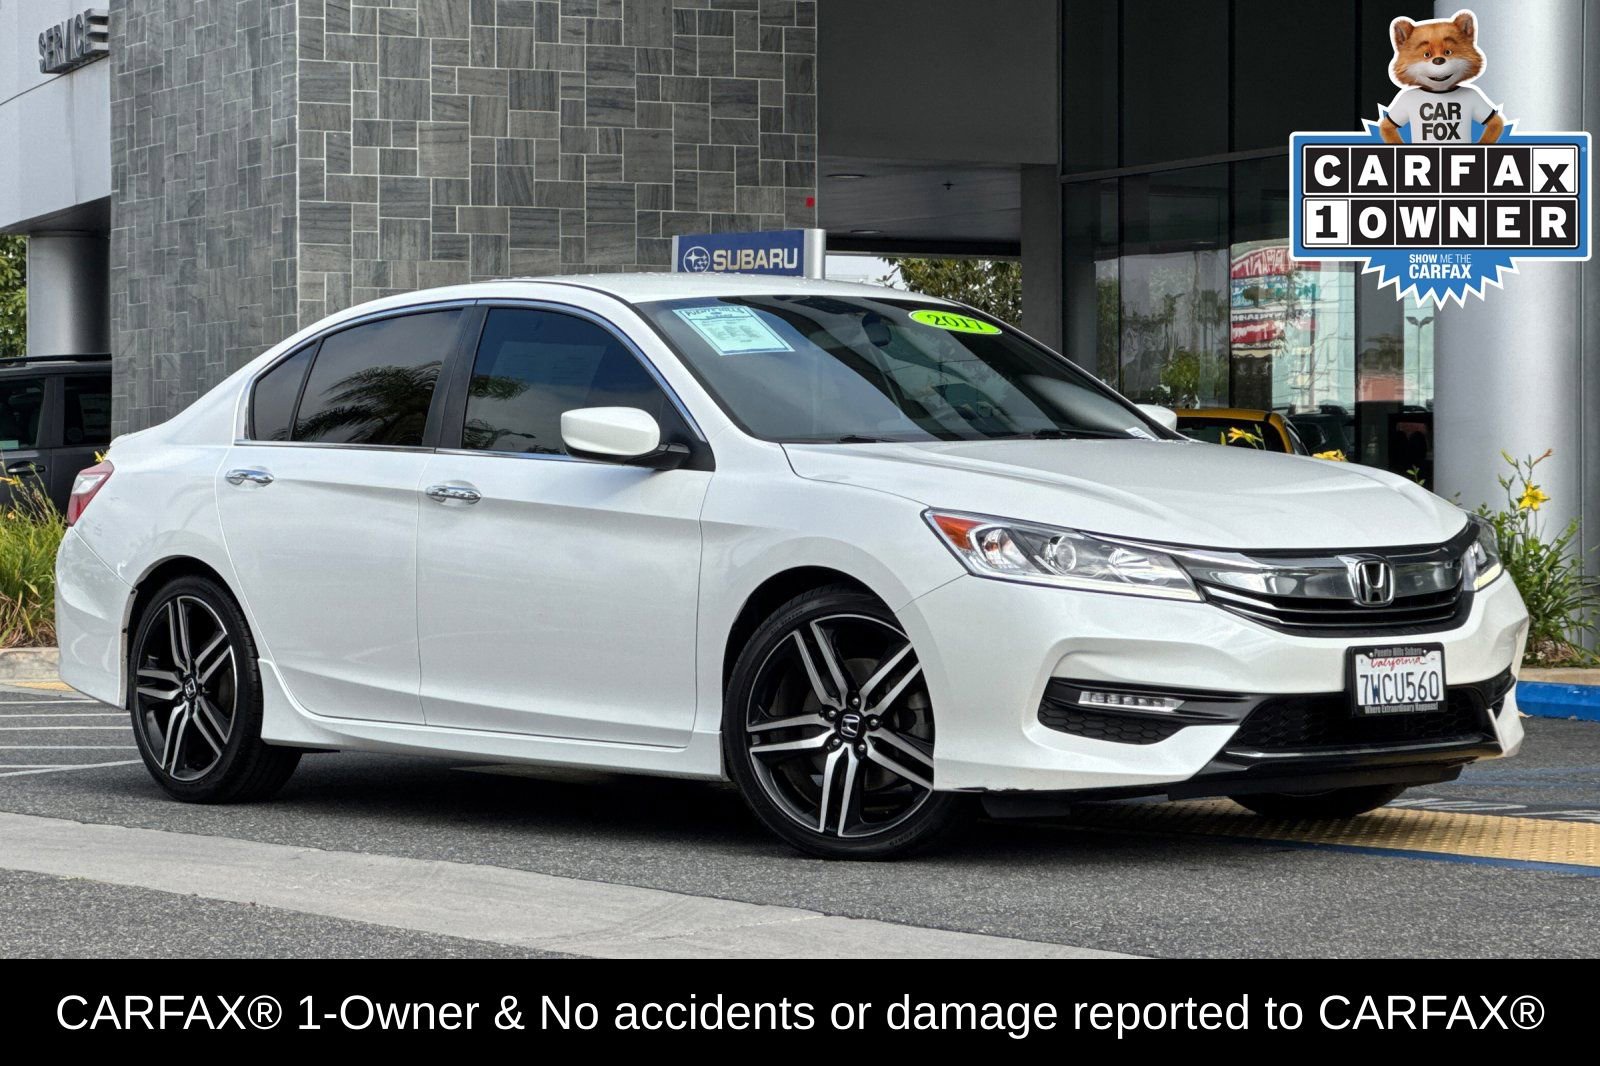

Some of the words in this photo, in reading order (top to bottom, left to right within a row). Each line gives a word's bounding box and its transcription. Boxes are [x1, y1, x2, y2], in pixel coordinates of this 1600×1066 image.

[38, 8, 109, 73] SERVICE
[713, 248, 798, 271] SUBARU
[927, 314, 983, 330] 2017
[1374, 648, 1392, 657] Puente
[1393, 647, 1404, 656] Hills
[1405, 647, 1422, 656] Subaru
[1371, 656, 1425, 671] California
[1360, 671, 1440, 704] 7WCU560
